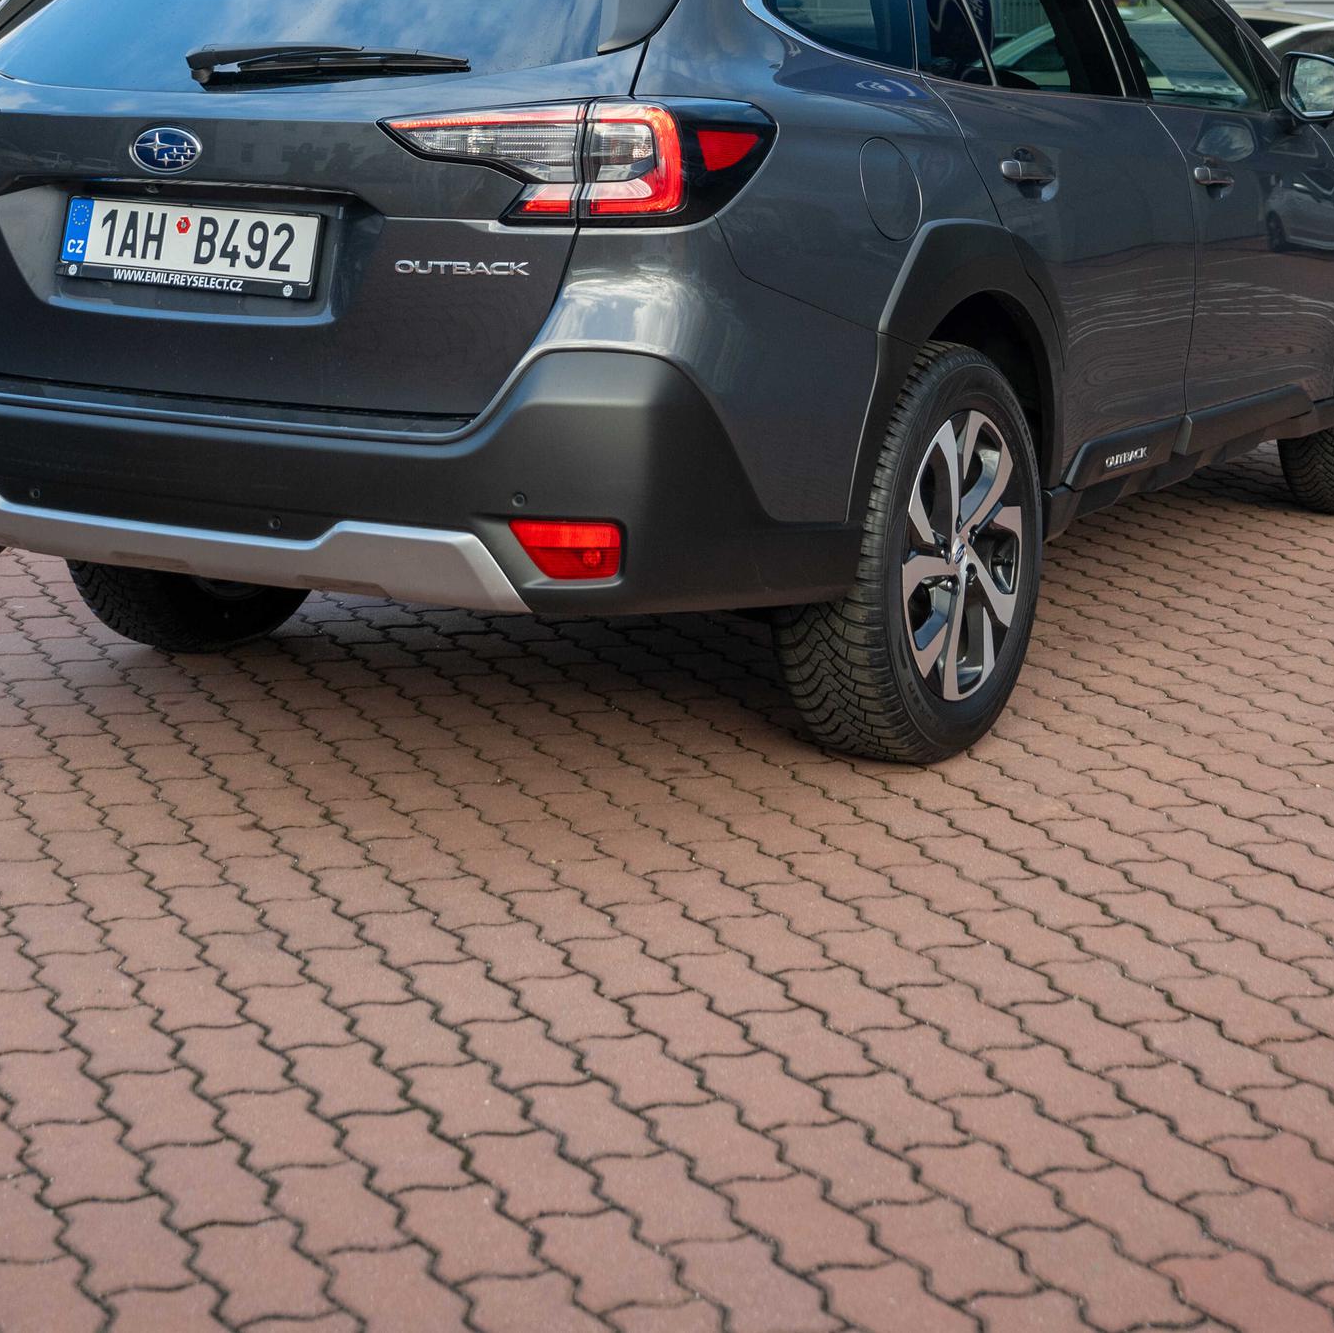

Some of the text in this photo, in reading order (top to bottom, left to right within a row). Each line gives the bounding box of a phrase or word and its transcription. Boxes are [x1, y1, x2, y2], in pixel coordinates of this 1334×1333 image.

[66, 208, 296, 272] CZ 1AH B492
[394, 259, 530, 276] OUTBACK
[113, 268, 244, 292] WWW.EMILFREYSELECT.CZ
[1105, 446, 1148, 468] OUTBACK
